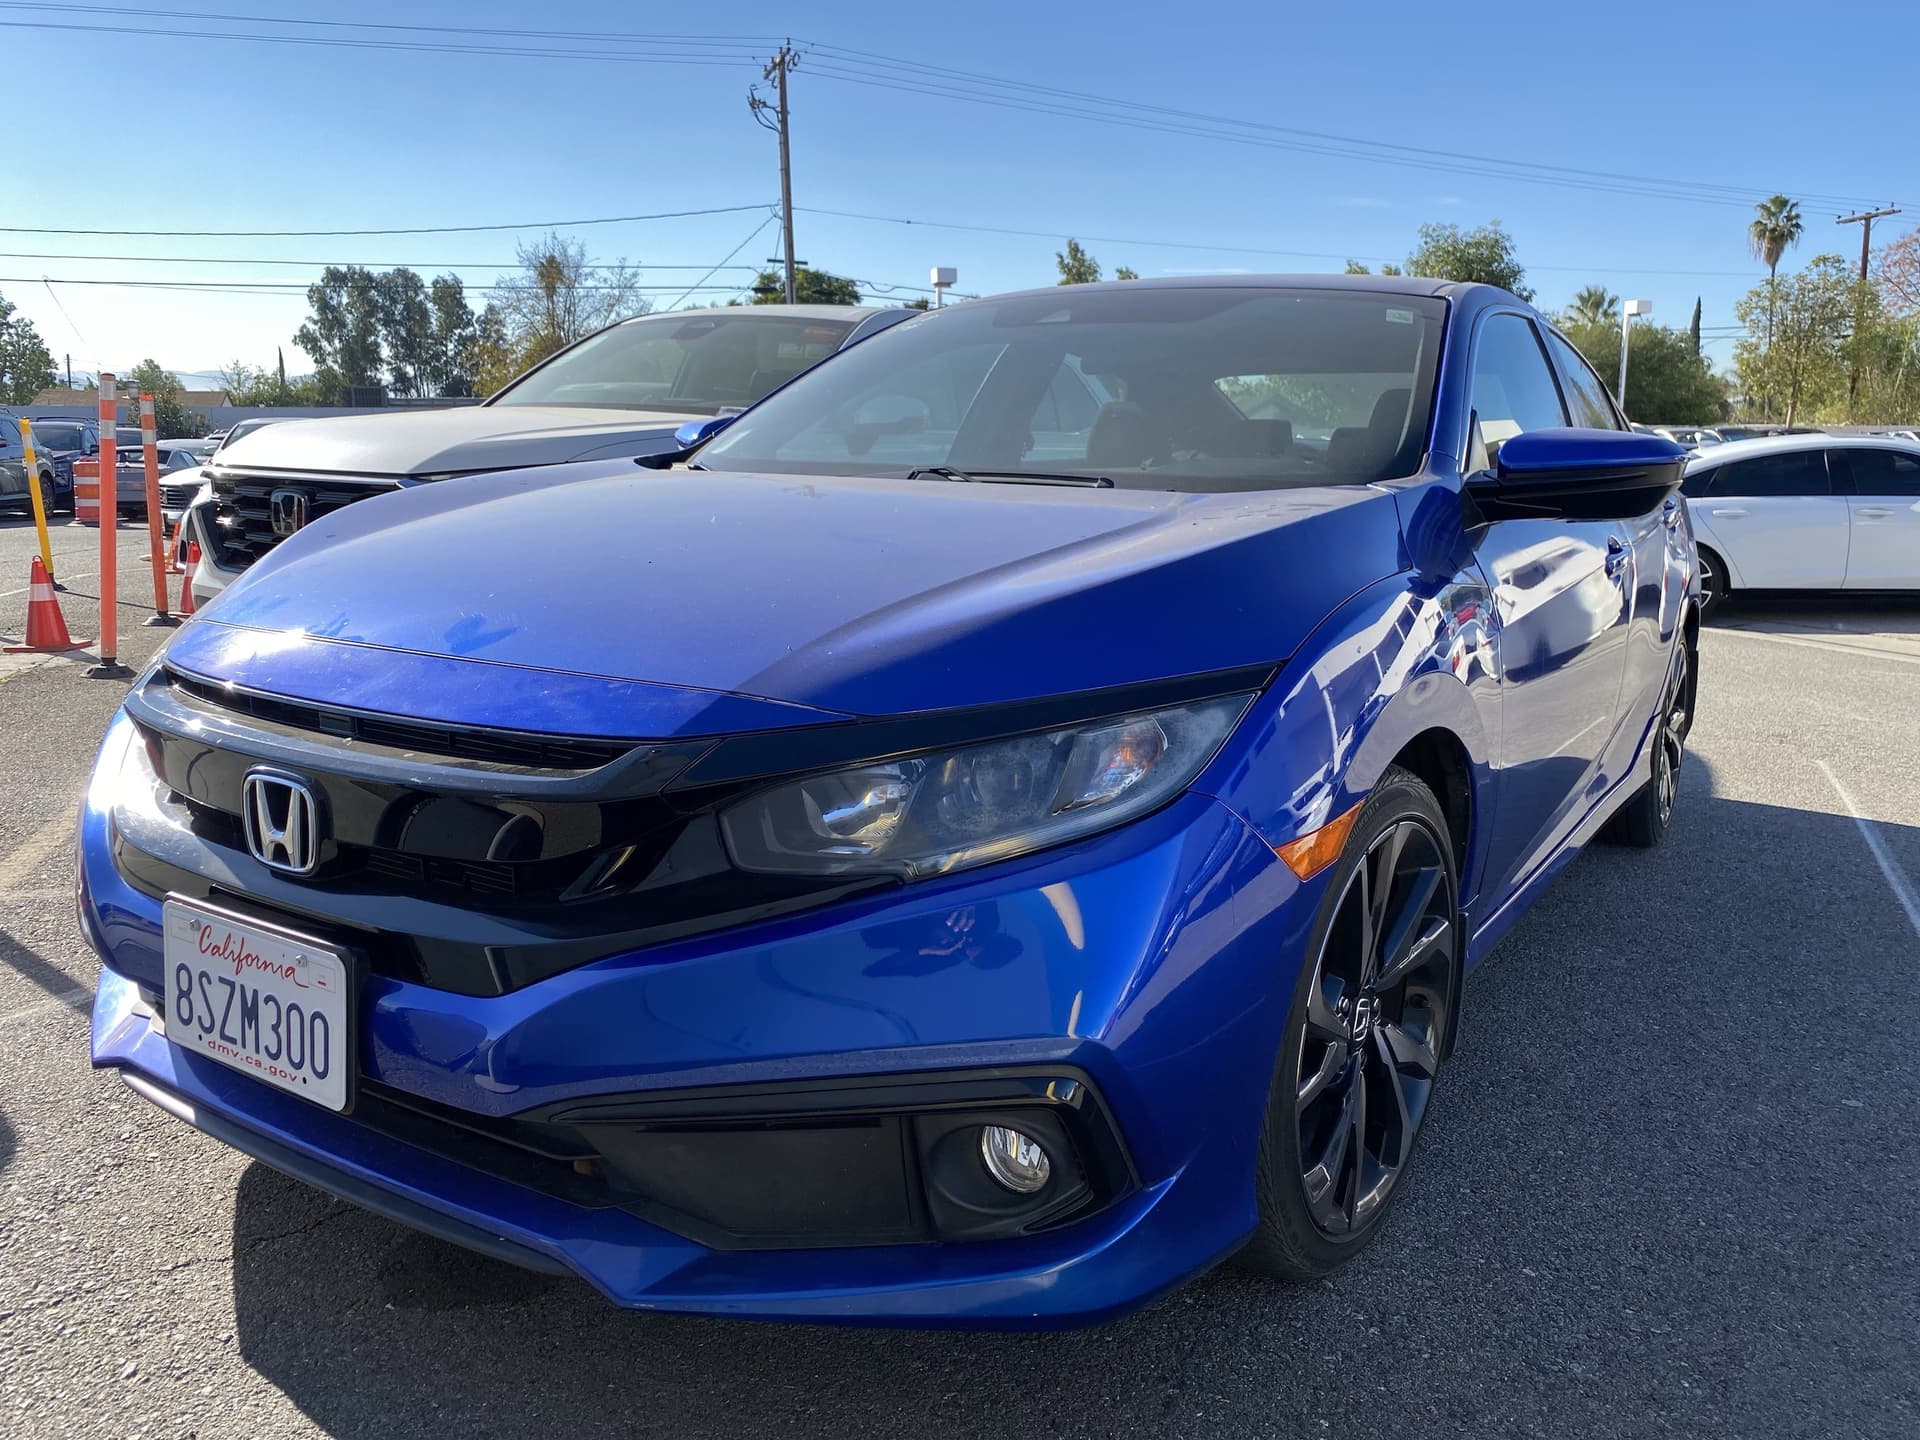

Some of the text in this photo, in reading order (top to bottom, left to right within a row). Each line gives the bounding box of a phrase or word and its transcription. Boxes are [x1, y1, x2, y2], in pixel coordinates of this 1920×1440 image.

[198, 924, 310, 989] California
[175, 962, 330, 1080] 8SZM300
[207, 1039, 299, 1083] dmv.ca.gov
